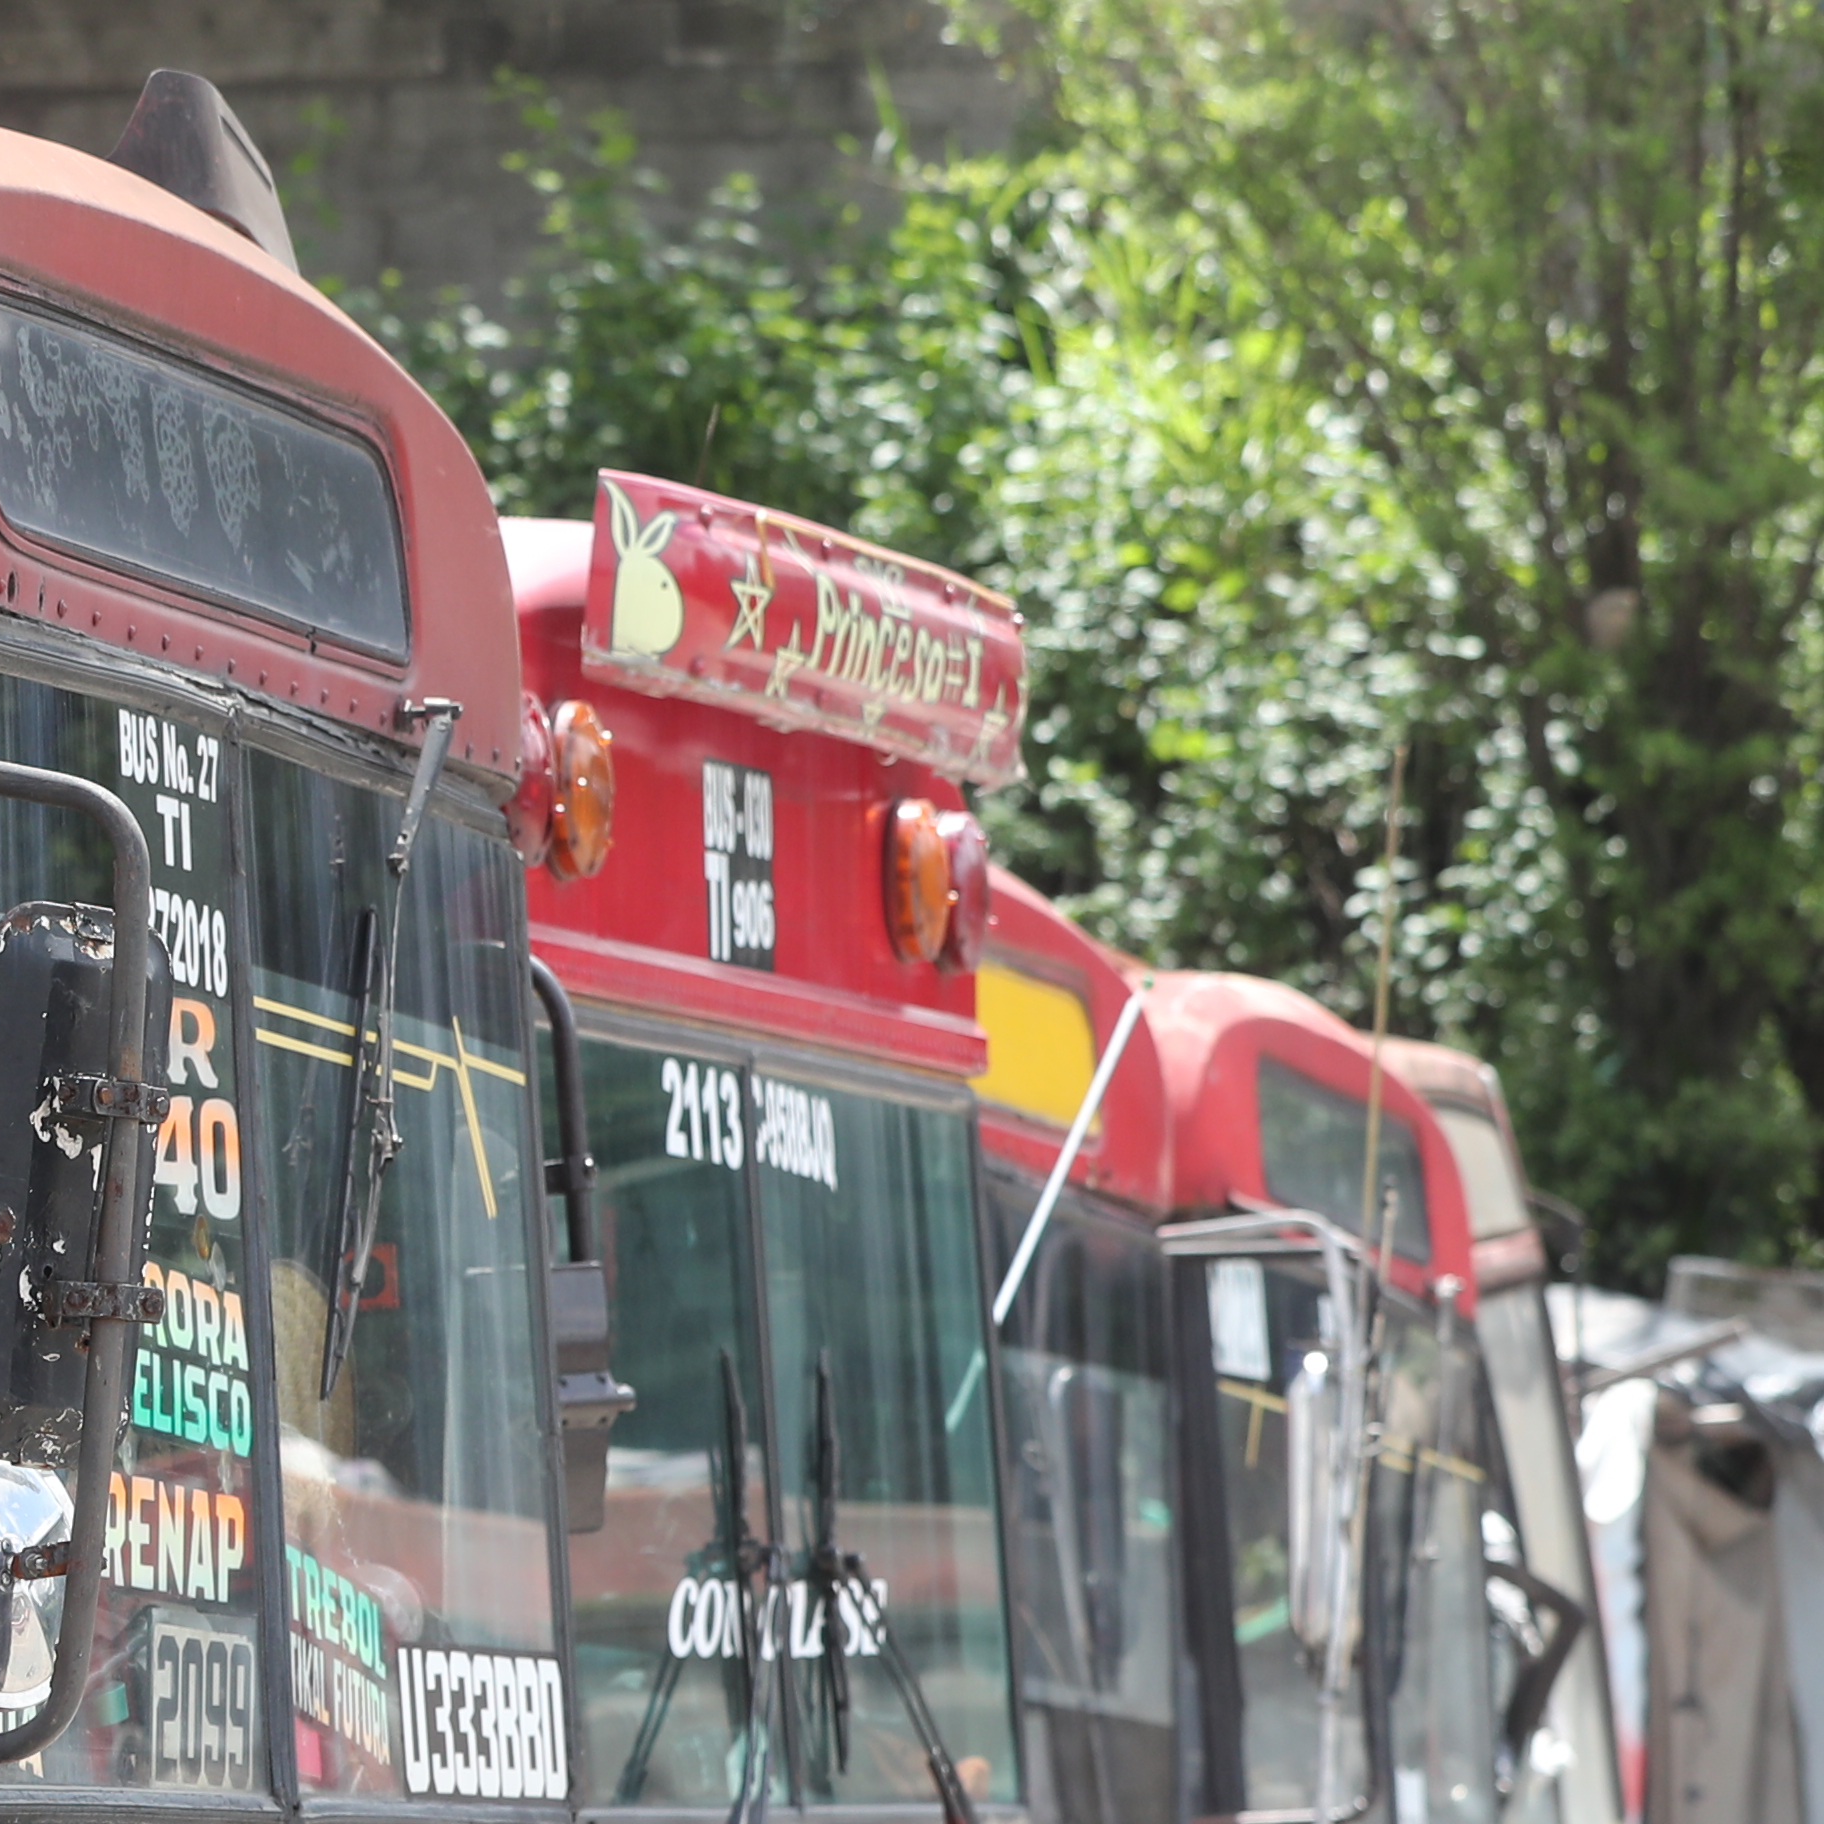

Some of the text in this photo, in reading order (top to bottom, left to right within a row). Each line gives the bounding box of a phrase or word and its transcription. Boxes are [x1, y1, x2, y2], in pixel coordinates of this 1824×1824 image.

[118, 708, 219, 803] BUS No. 27
[156, 793, 192, 871] TI
[148, 886, 228, 998] 72018
[732, 879, 776, 950] 906
[166, 997, 219, 1089] R
[155, 1095, 241, 1220] 40
[662, 1057, 744, 1171] 2113
[101, 1470, 245, 1604] RENAP
[285, 1543, 387, 1681] TREBOL
[156, 1634, 252, 1790] 2099
[290, 1630, 392, 1767] TIKAL FUTURA
[397, 1647, 569, 1800] U333BBD
